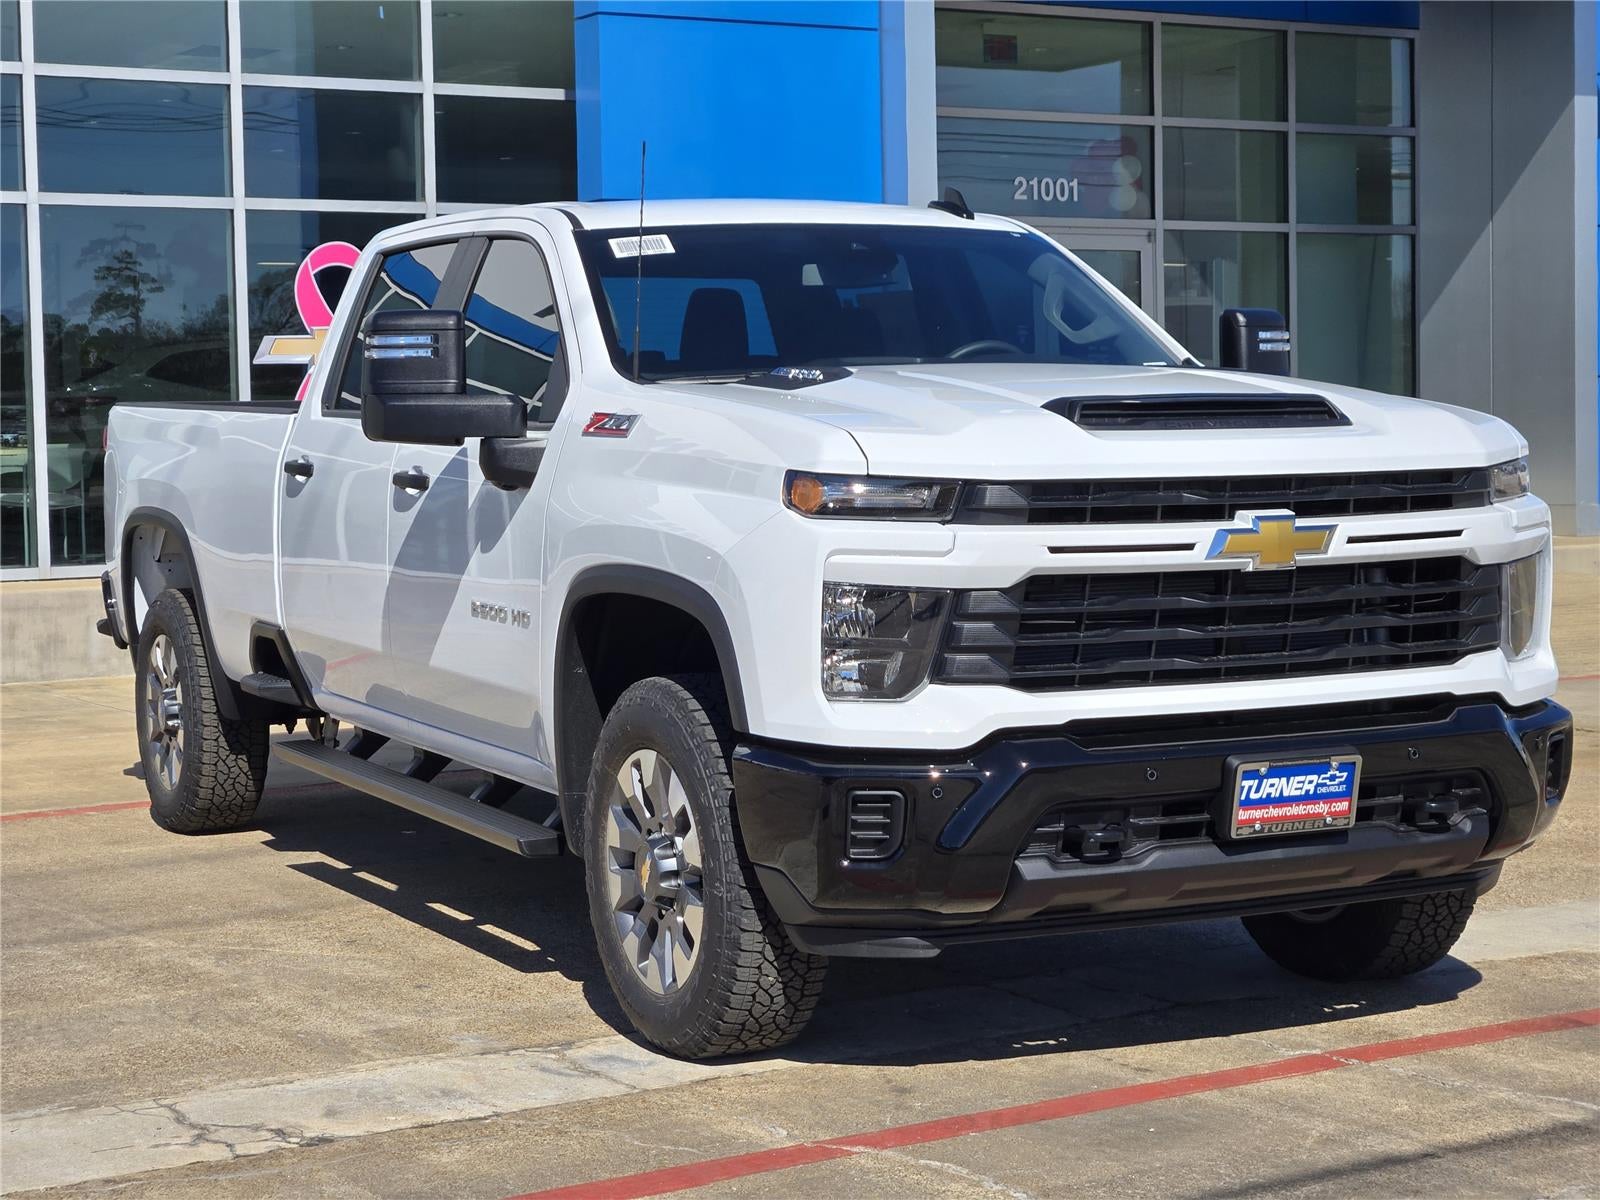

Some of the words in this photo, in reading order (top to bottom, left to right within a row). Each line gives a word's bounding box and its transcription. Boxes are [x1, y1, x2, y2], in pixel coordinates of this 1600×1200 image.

[1013, 176, 1079, 202] 21001
[1240, 775, 1319, 800] TURNER
[1317, 785, 1346, 794] CHEVROLET
[1238, 801, 1349, 820] turnerchevroletcrosby.com
[1262, 820, 1325, 833] TURNER
